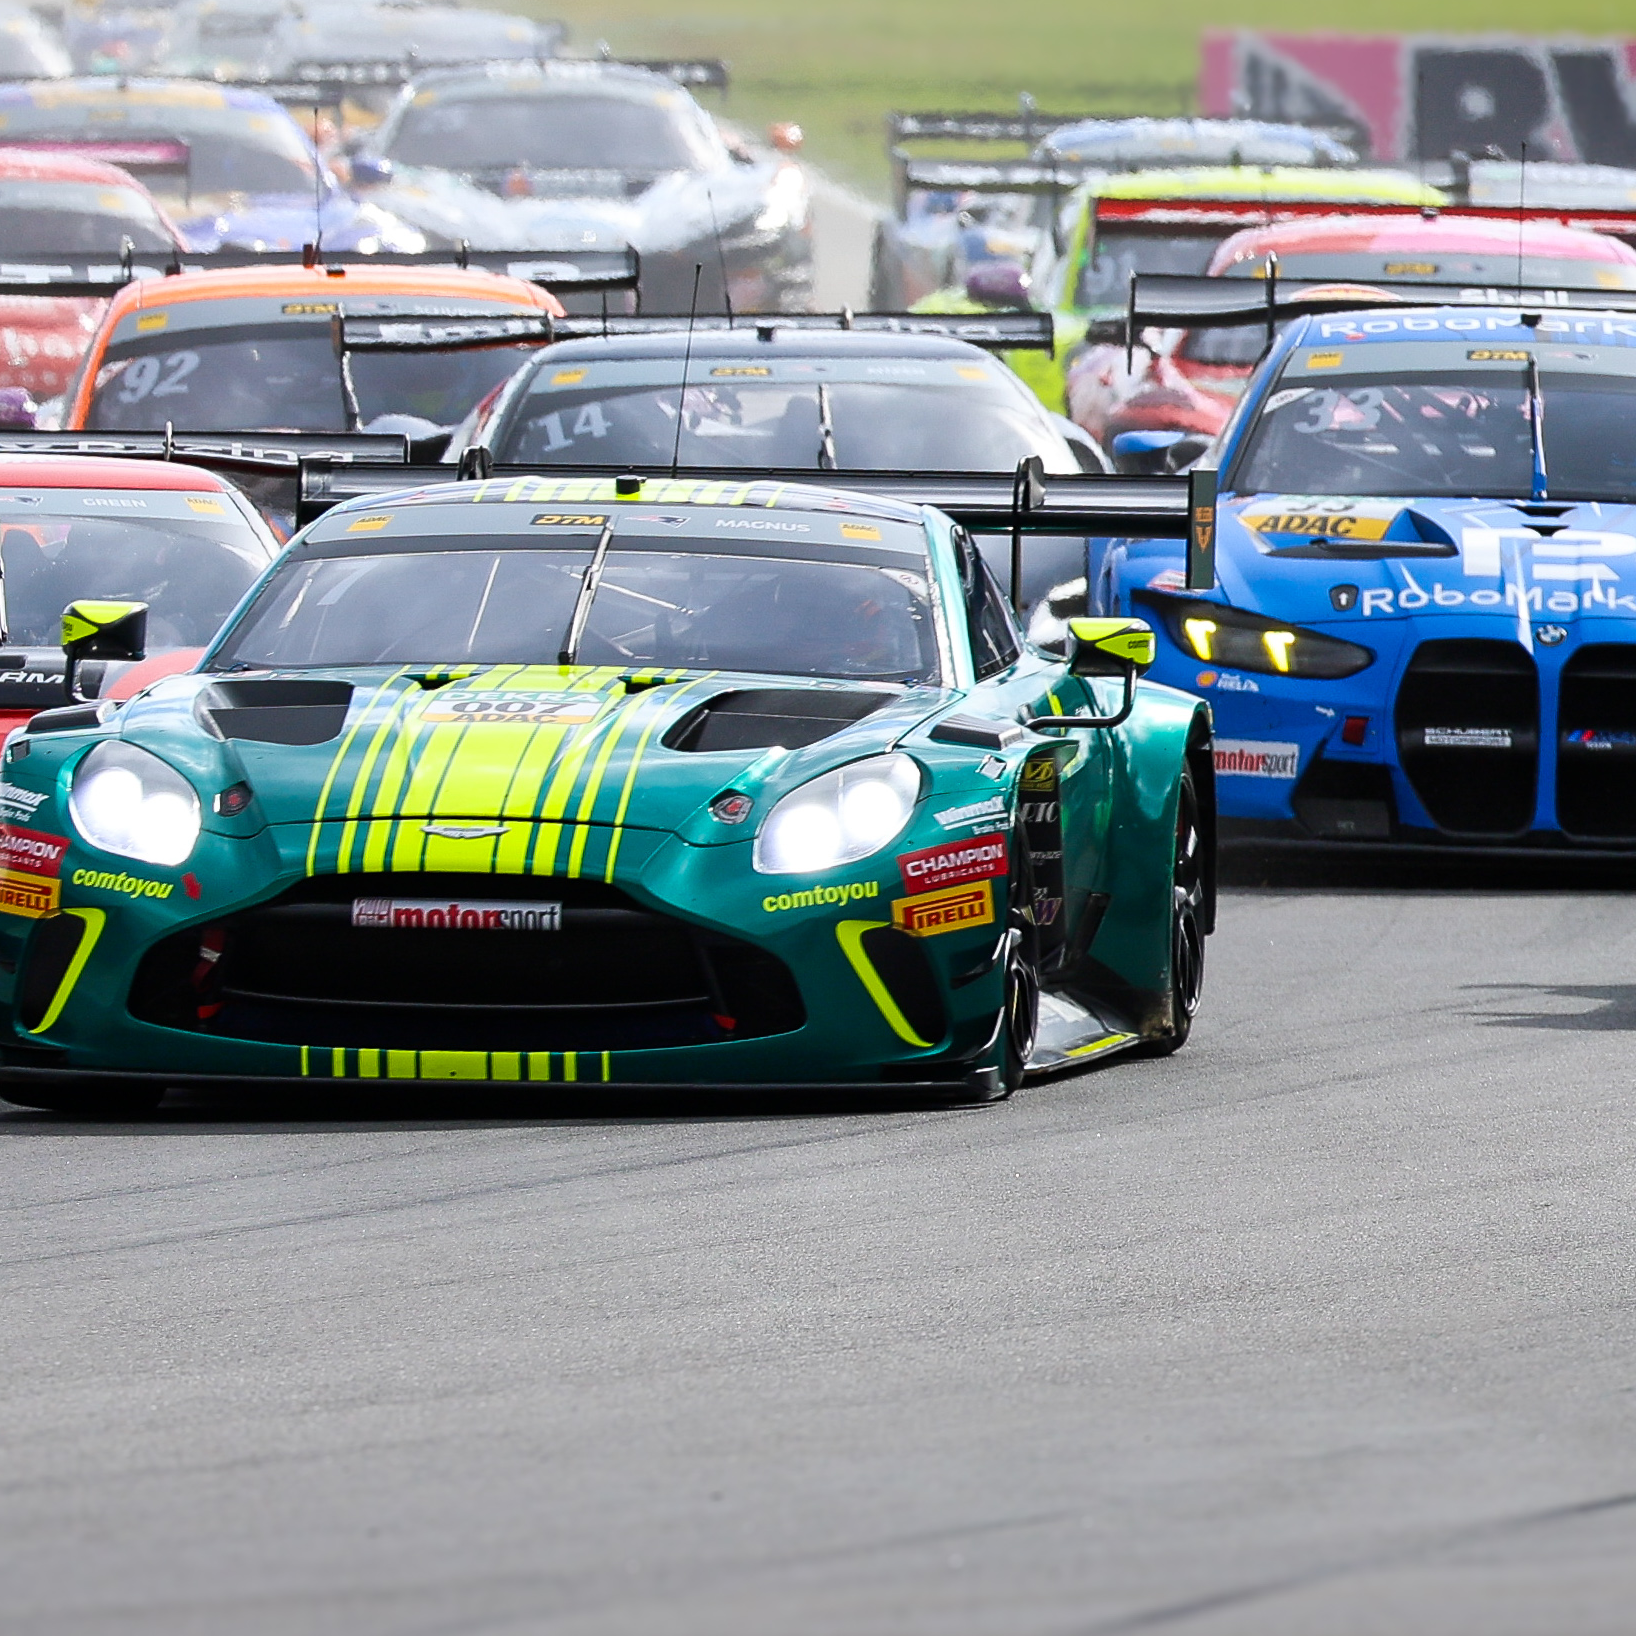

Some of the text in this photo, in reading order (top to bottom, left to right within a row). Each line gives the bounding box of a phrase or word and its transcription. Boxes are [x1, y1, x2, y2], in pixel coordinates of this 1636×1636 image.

[1459, 288, 1569, 306] Shell
[1471, 350, 1530, 361] DTM
[118, 349, 202, 405] 92
[1294, 388, 1386, 434] 33
[539, 400, 612, 452] 14
[82, 497, 148, 509] GREEN
[535, 515, 606, 525] DTM
[715, 519, 811, 533] MAGNUS
[1257, 515, 1357, 536] ADAC
[442, 691, 596, 702] DEKRA
[452, 701, 577, 714] 007
[452, 713, 561, 724] ADAC
[1214, 748, 1296, 777] motorsport
[905, 843, 1004, 877] CHAMPION
[72, 867, 174, 900] comtoyou
[924, 863, 996, 884] LUBRICANTS
[763, 877, 879, 912] comtoyou
[393, 903, 559, 930] motorsport
[902, 890, 986, 930] PIRELLI
